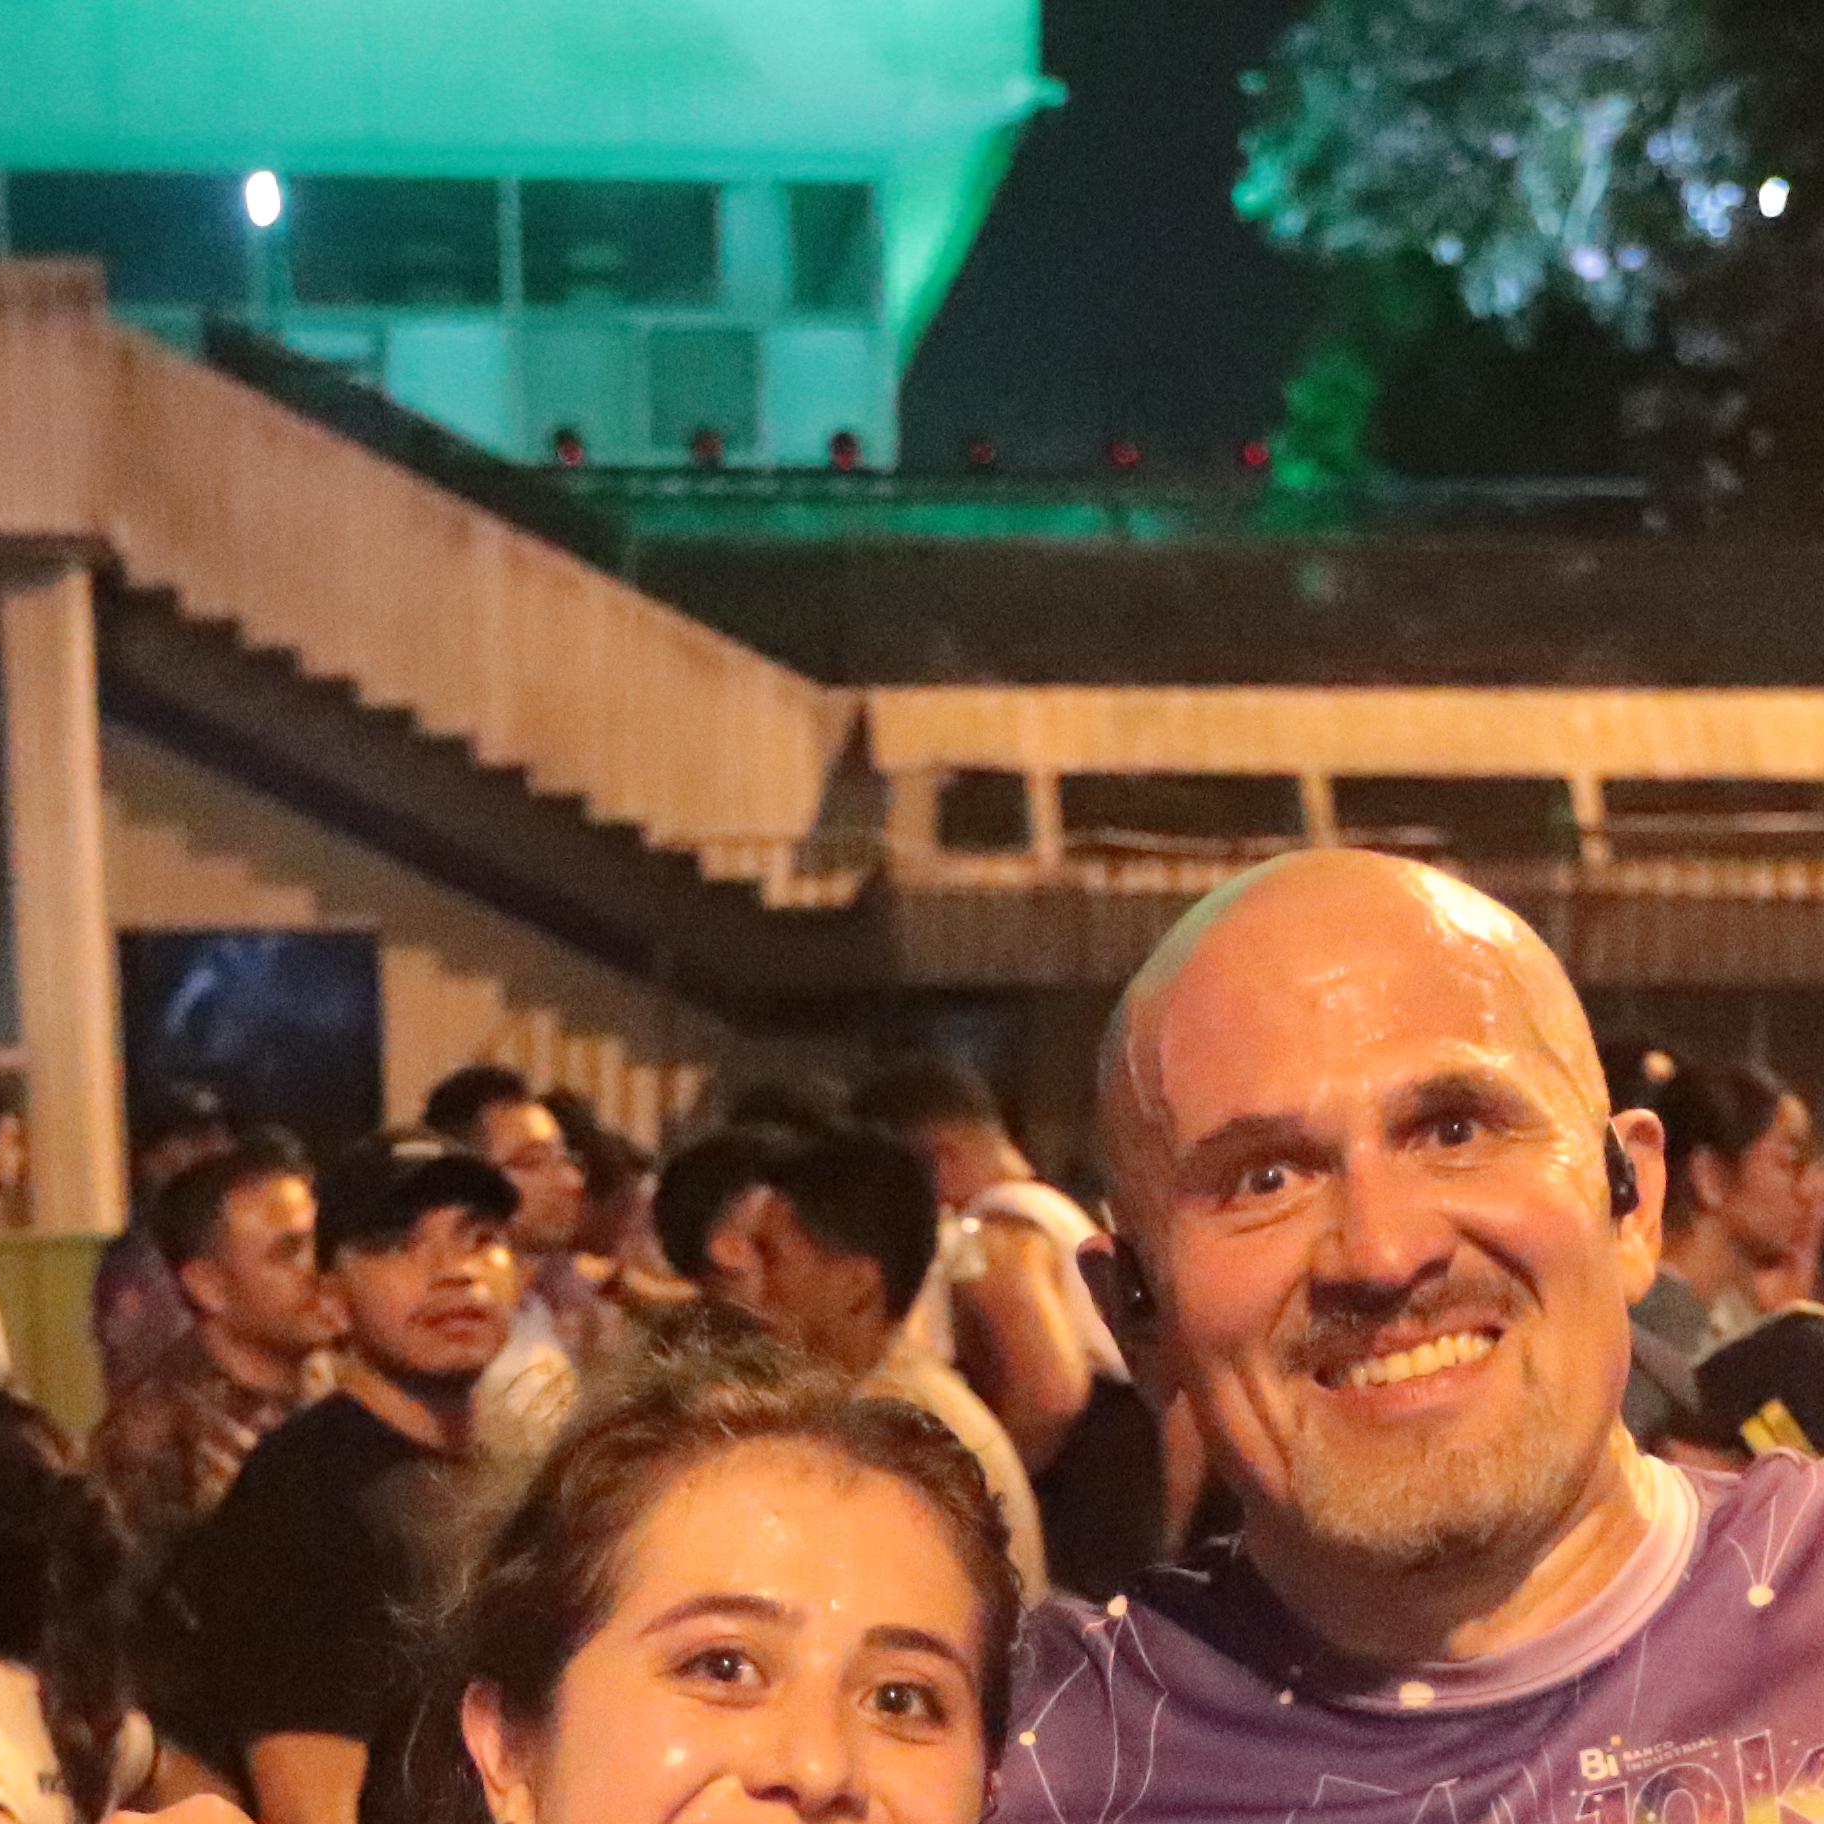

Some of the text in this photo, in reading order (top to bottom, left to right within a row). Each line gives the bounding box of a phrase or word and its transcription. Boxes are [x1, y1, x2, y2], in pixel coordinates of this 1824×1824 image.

[1579, 1735, 1621, 1780] Bi
[1622, 1740, 1676, 1761] BANCO
[1625, 1737, 1718, 1771] INDUSTRIAL
